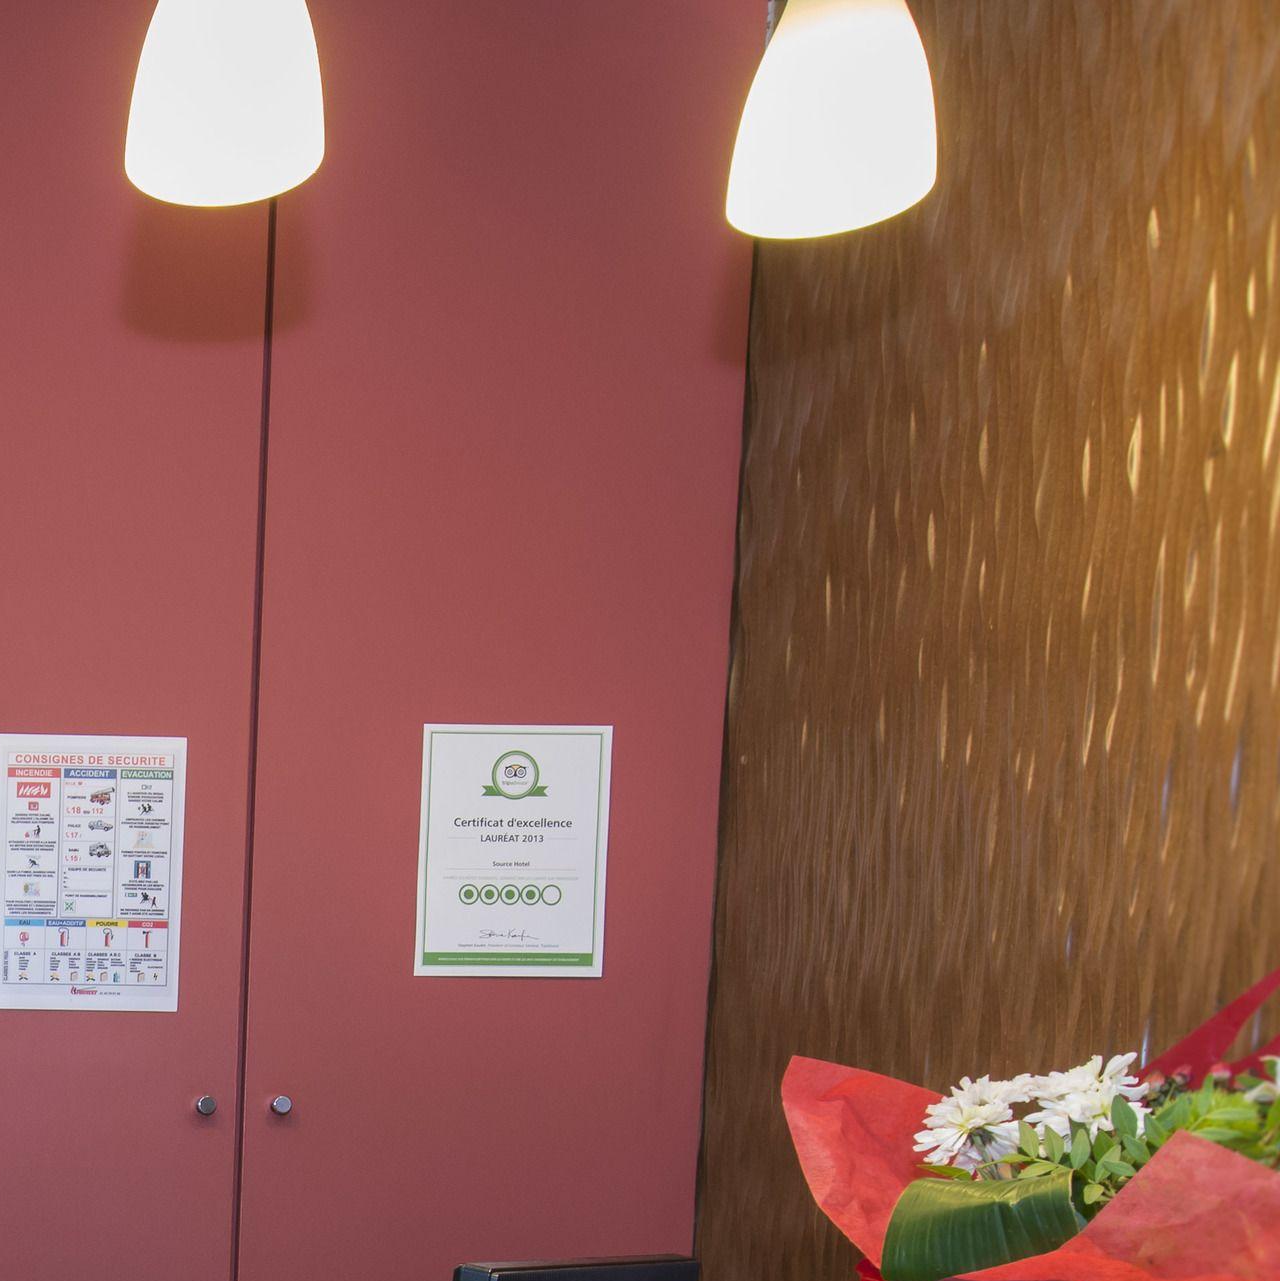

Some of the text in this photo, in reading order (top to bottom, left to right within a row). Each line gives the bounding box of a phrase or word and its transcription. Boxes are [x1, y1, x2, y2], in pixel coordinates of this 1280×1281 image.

[15, 754, 84, 764] CONSIGNES
[89, 755, 103, 765] DE
[15, 769, 53, 777] INCENDIE
[69, 769, 111, 778] ACCIDENT
[121, 770, 173, 779] EVACUATION
[71, 806, 104, 815] 18 112
[453, 817, 573, 828] Certificat d'excellence
[480, 832, 544, 843] LAURÉAT 2013
[492, 860, 531, 868] Source Hotel
